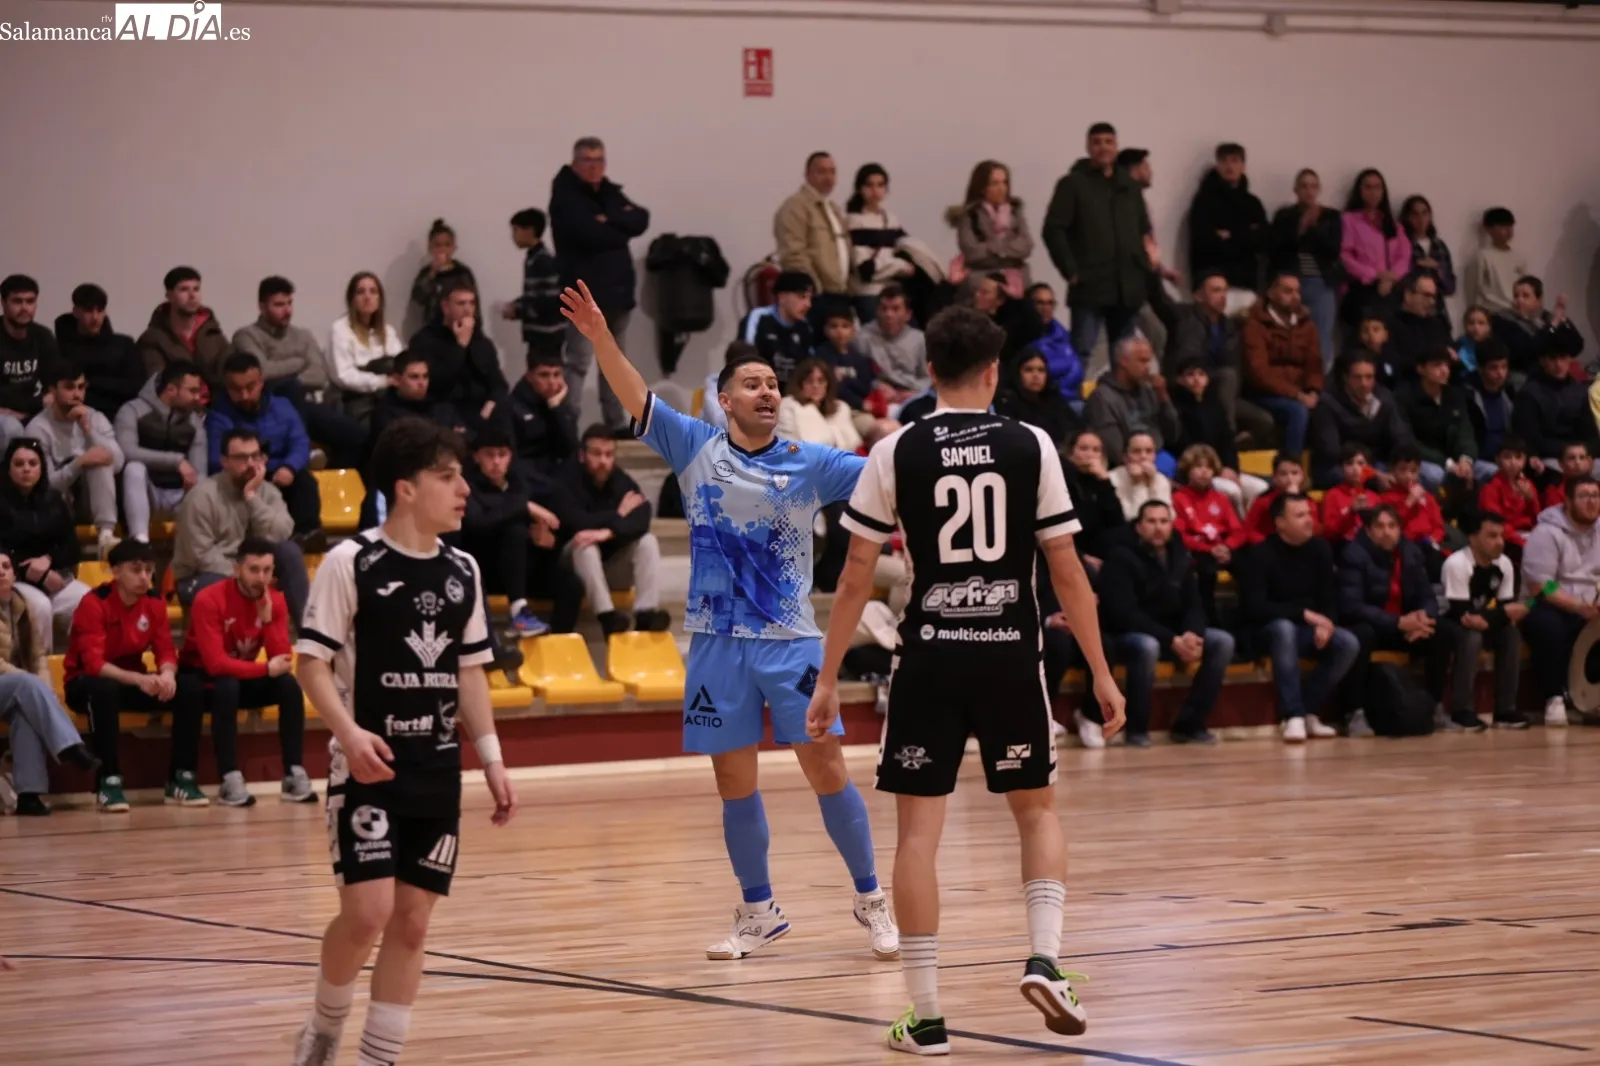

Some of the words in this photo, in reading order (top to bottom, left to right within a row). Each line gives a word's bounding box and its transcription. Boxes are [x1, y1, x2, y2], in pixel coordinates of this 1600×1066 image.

[941, 445, 995, 467] SAMUEL
[934, 472, 1007, 564] 20
[937, 626, 1021, 642] multicolchón
[381, 672, 421, 690] CAJA
[423, 672, 459, 689] RURA
[684, 714, 722, 728] ACTIO
